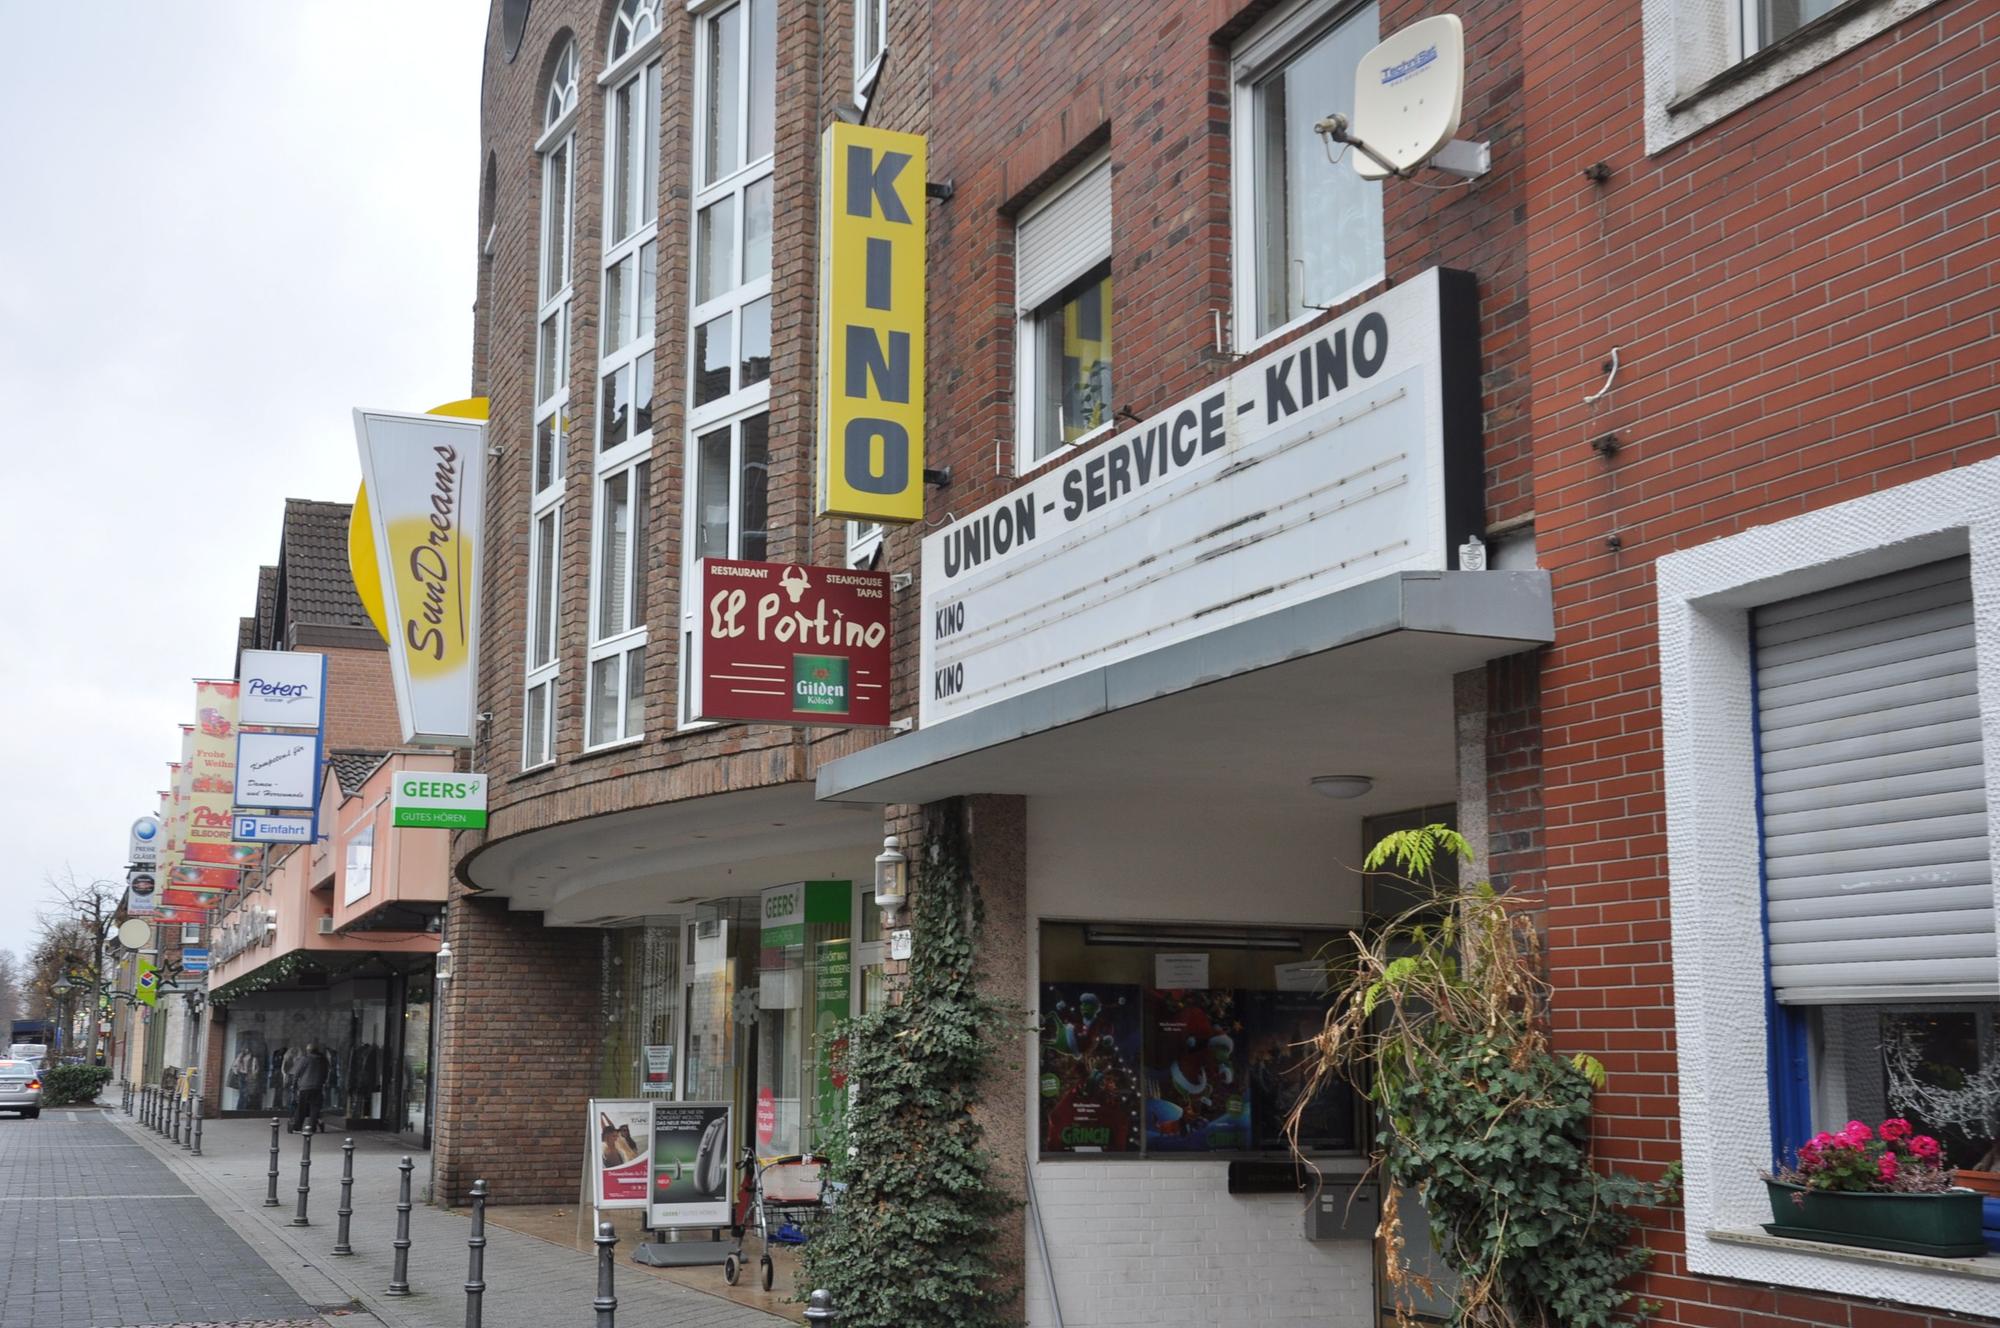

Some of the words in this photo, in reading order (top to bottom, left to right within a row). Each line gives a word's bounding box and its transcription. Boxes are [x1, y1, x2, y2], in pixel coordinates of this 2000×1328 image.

[844, 144, 913, 495] KINO
[943, 492, 1036, 579] UNION
[1062, 391, 1226, 522] SERVICE
[1266, 311, 1389, 425] KINO
[407, 444, 458, 661] SunDreams
[710, 566, 768, 579] RESTAURANT
[826, 574, 883, 587] STEAKHOUSE
[856, 588, 883, 598] TAPAS
[710, 589, 747, 639] El
[758, 592, 886, 648] Portino
[935, 600, 964, 640] KINO
[248, 678, 308, 696] Peters
[796, 680, 844, 697] Gilden
[935, 661, 963, 700] KINO
[807, 696, 834, 706] Kölsch
[197, 750, 225, 758] Frohe
[403, 781, 466, 799] GEERS
[401, 812, 432, 822] GUTES
[434, 812, 466, 822] HÖREN
[260, 823, 305, 835] Einfahrt
[765, 894, 794, 919] GEERS
